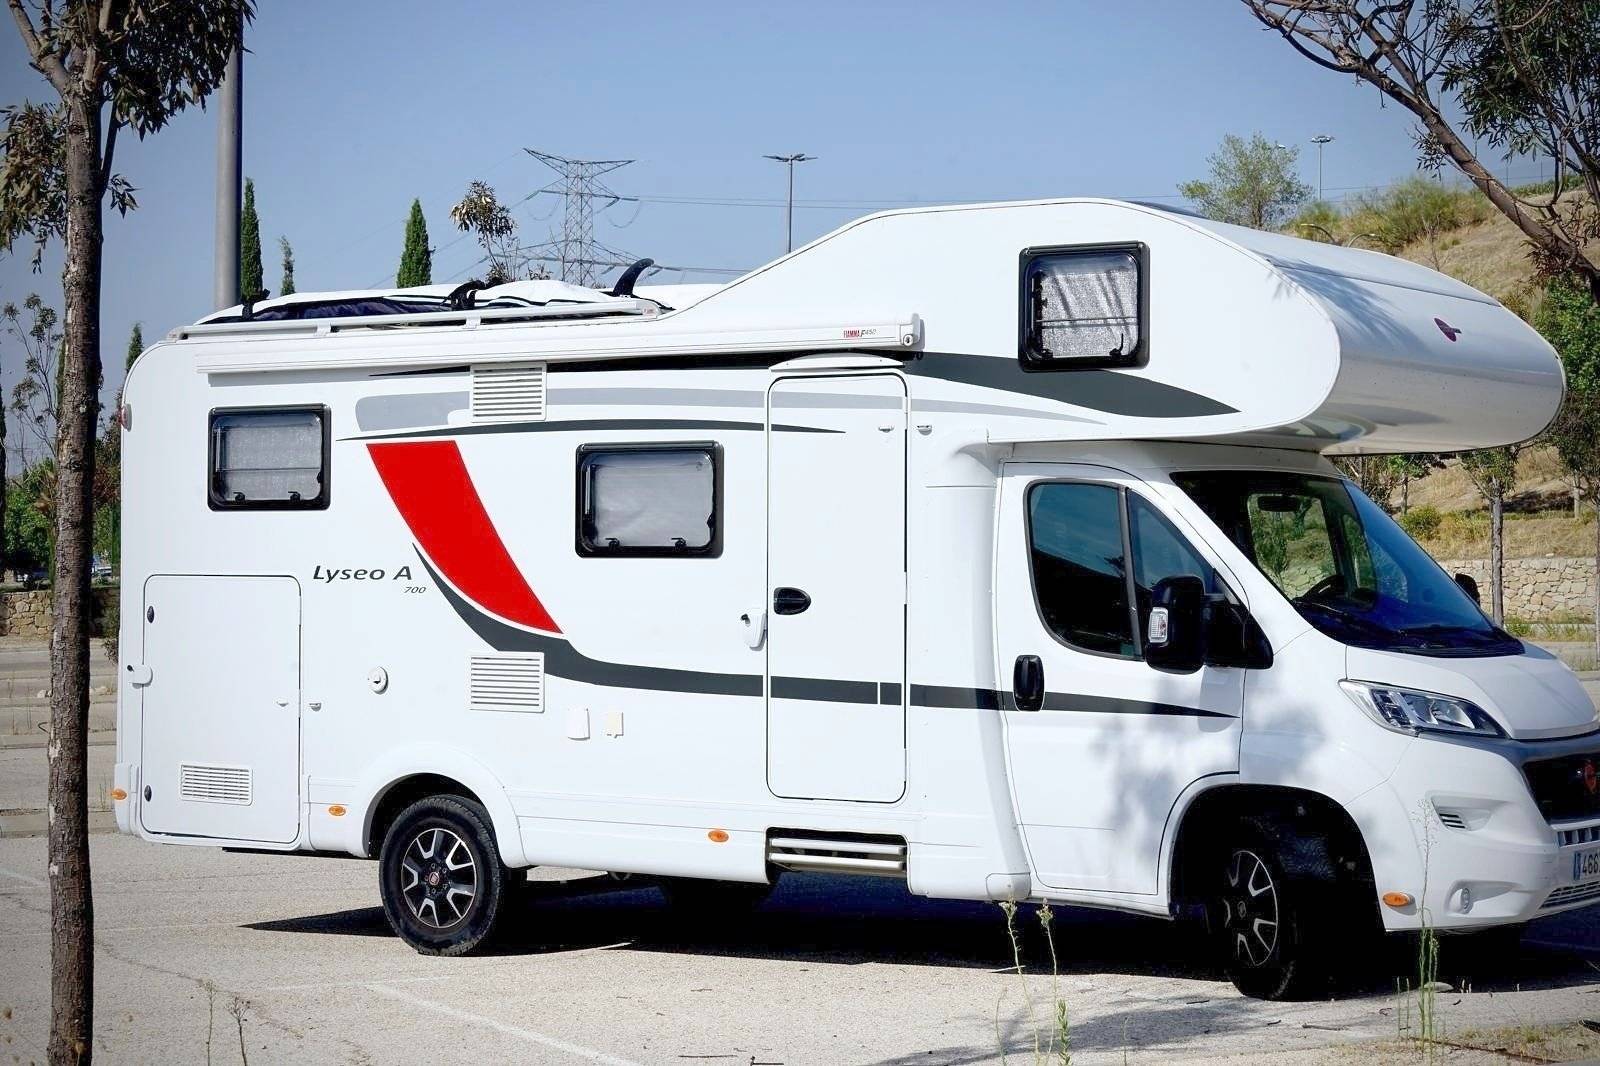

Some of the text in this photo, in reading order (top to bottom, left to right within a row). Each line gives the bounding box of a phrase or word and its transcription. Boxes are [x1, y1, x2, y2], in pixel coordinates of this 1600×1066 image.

[843, 329, 860, 339] FIAMMA
[312, 565, 412, 584] Lyseo A
[403, 586, 427, 594] 700
[1582, 853, 1600, 875] 466
